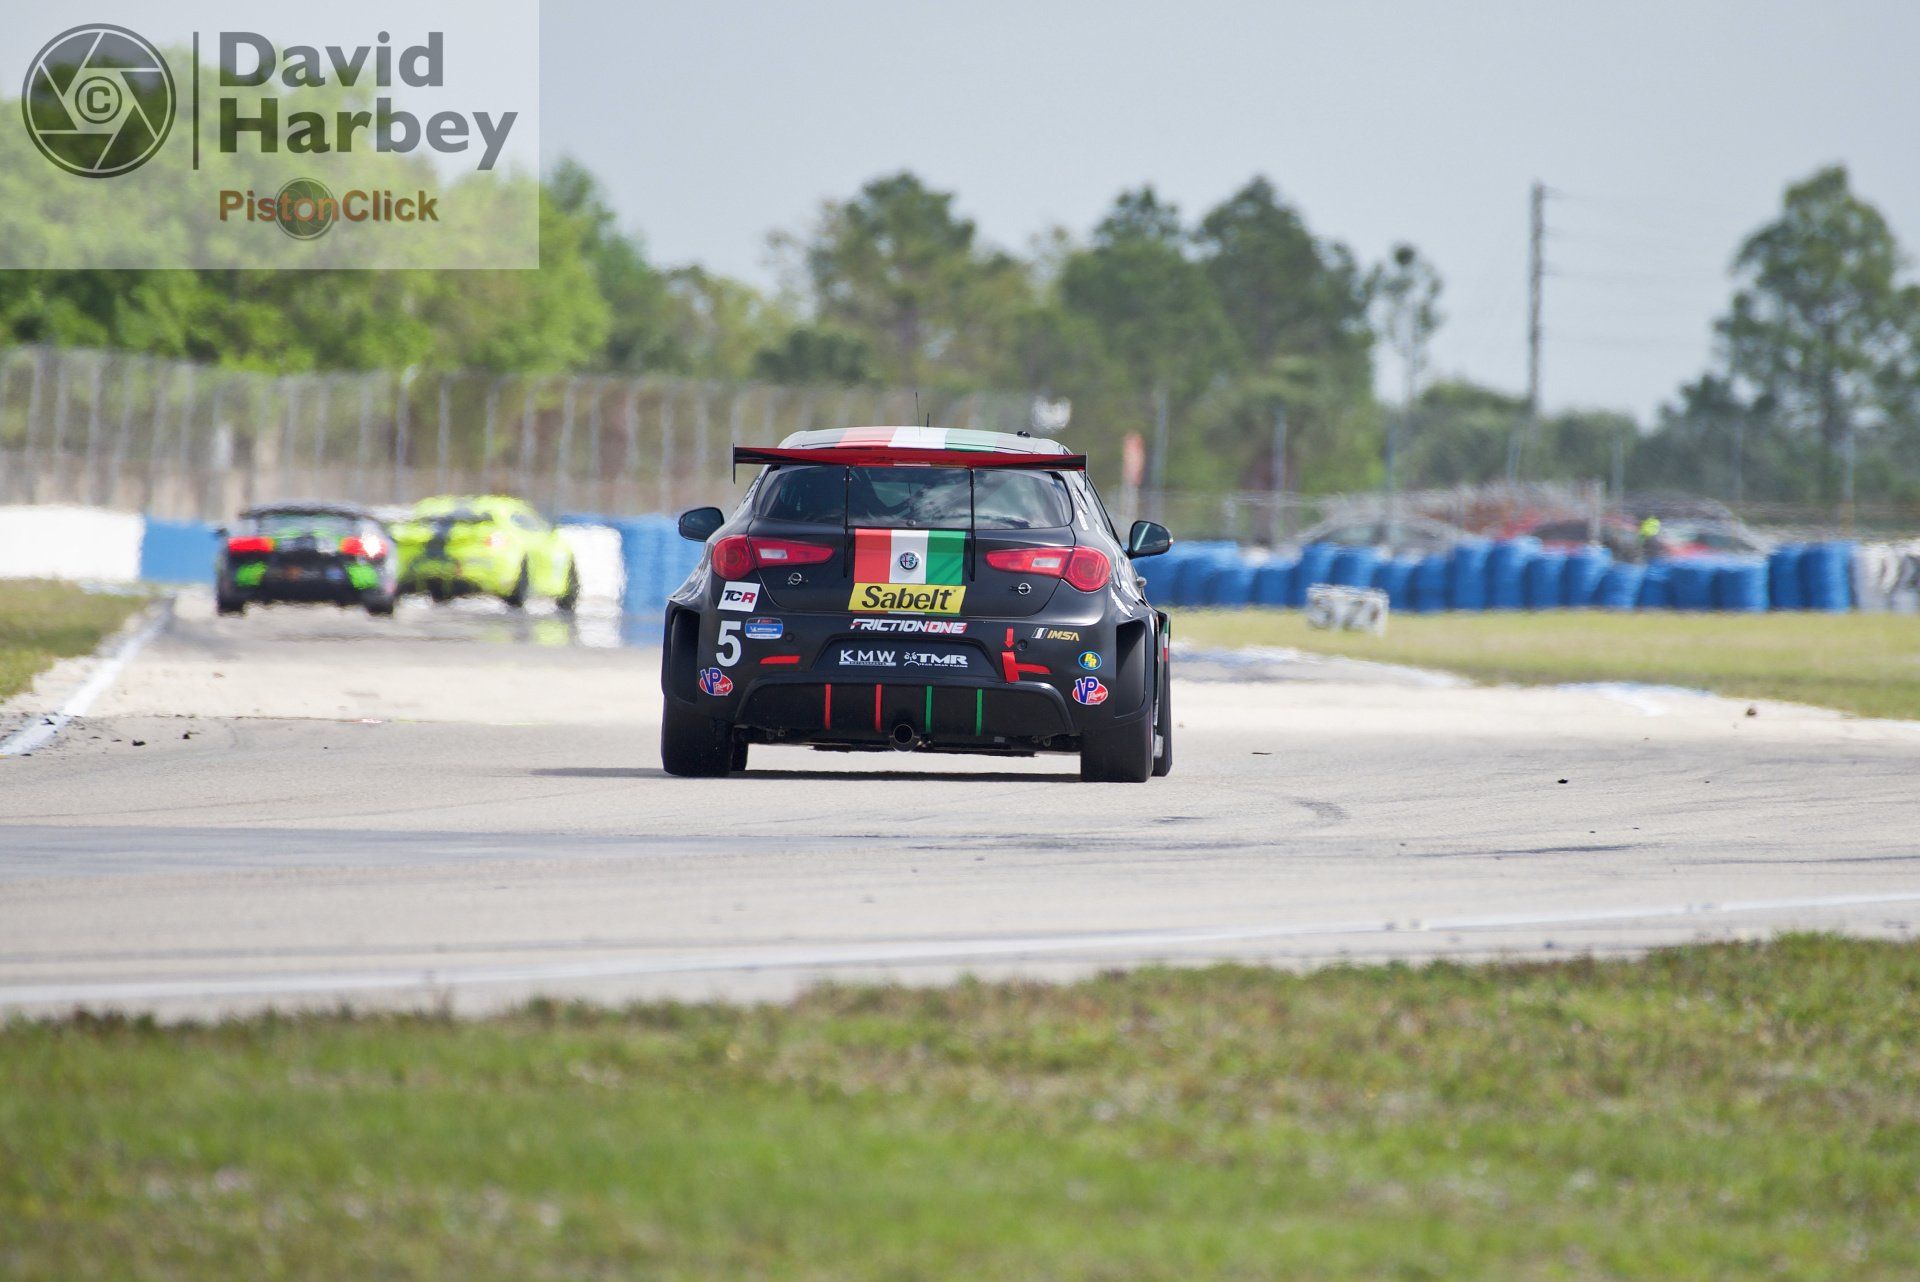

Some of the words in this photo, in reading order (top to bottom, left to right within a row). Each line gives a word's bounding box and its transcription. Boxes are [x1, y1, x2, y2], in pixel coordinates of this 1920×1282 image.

[724, 590, 756, 604] TCR
[861, 585, 953, 611] Sabelt
[715, 620, 742, 667] 5
[1047, 629, 1080, 642] IMSA
[840, 649, 896, 663] KMW
[916, 653, 969, 665] TMR
[700, 667, 722, 695] VP
[1075, 676, 1099, 704] VP
